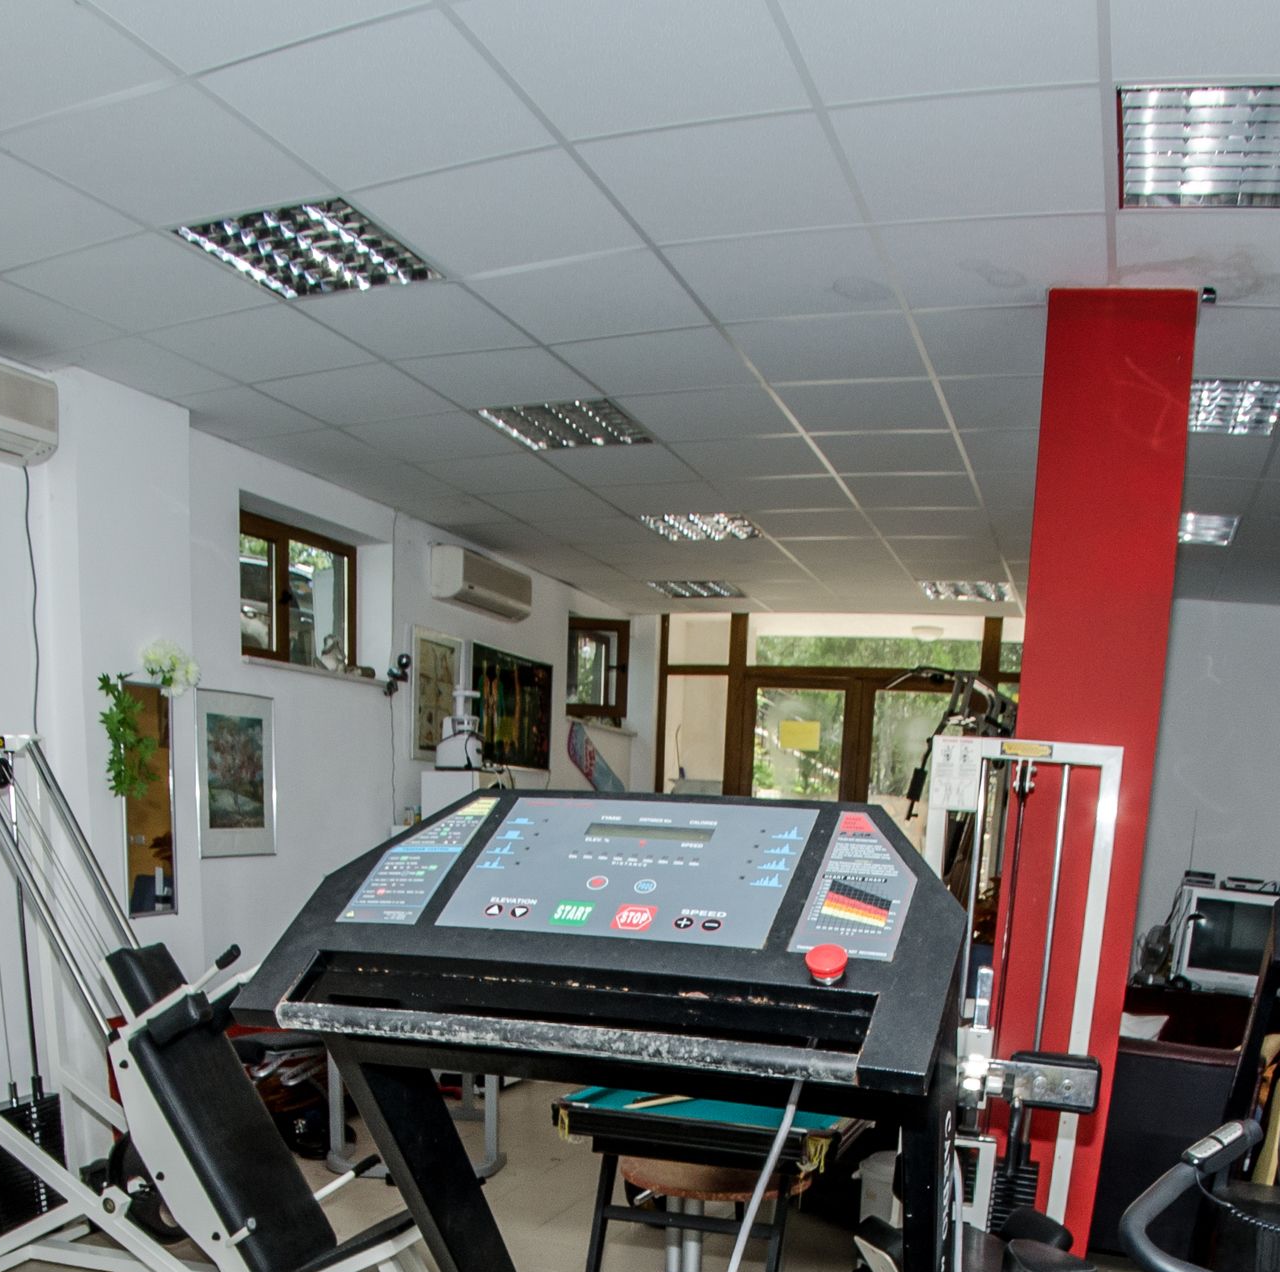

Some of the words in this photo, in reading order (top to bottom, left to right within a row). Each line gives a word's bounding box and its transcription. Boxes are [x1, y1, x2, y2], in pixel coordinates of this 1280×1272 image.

[490, 896, 538, 906] ELEVATION
[553, 904, 593, 921] START
[619, 910, 649, 925] STOP
[680, 907, 728, 918] SPEED
